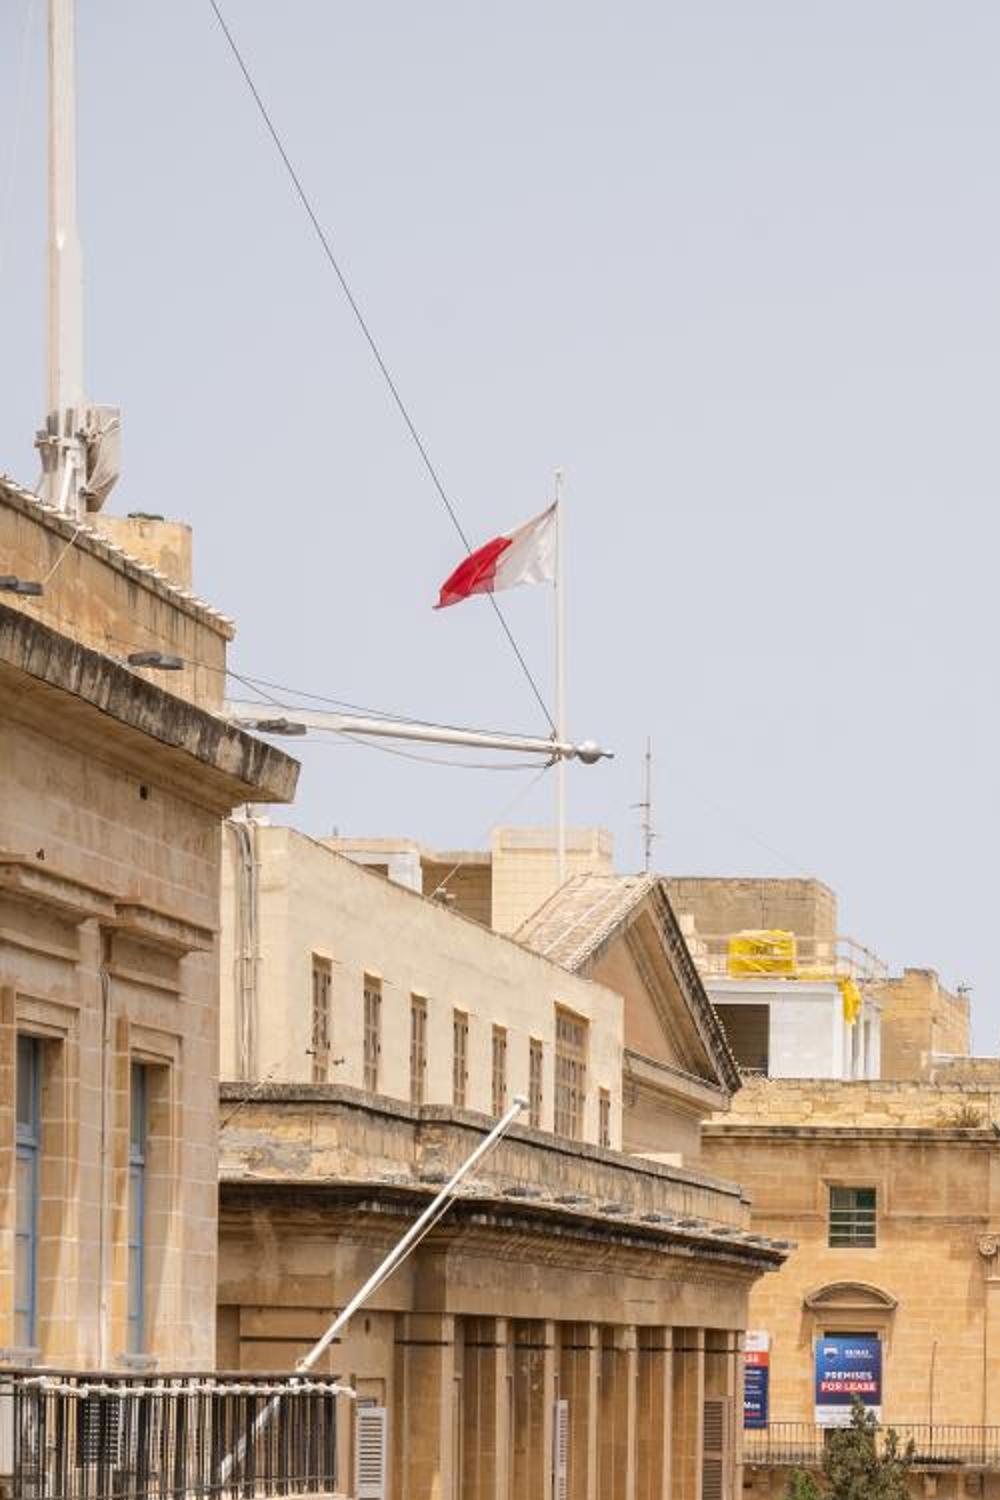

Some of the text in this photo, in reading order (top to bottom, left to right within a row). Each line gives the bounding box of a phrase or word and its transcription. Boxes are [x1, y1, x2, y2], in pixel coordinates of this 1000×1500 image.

[824, 1371, 873, 1381] PREMISES
[821, 1381, 877, 1392] FOR LEASE
